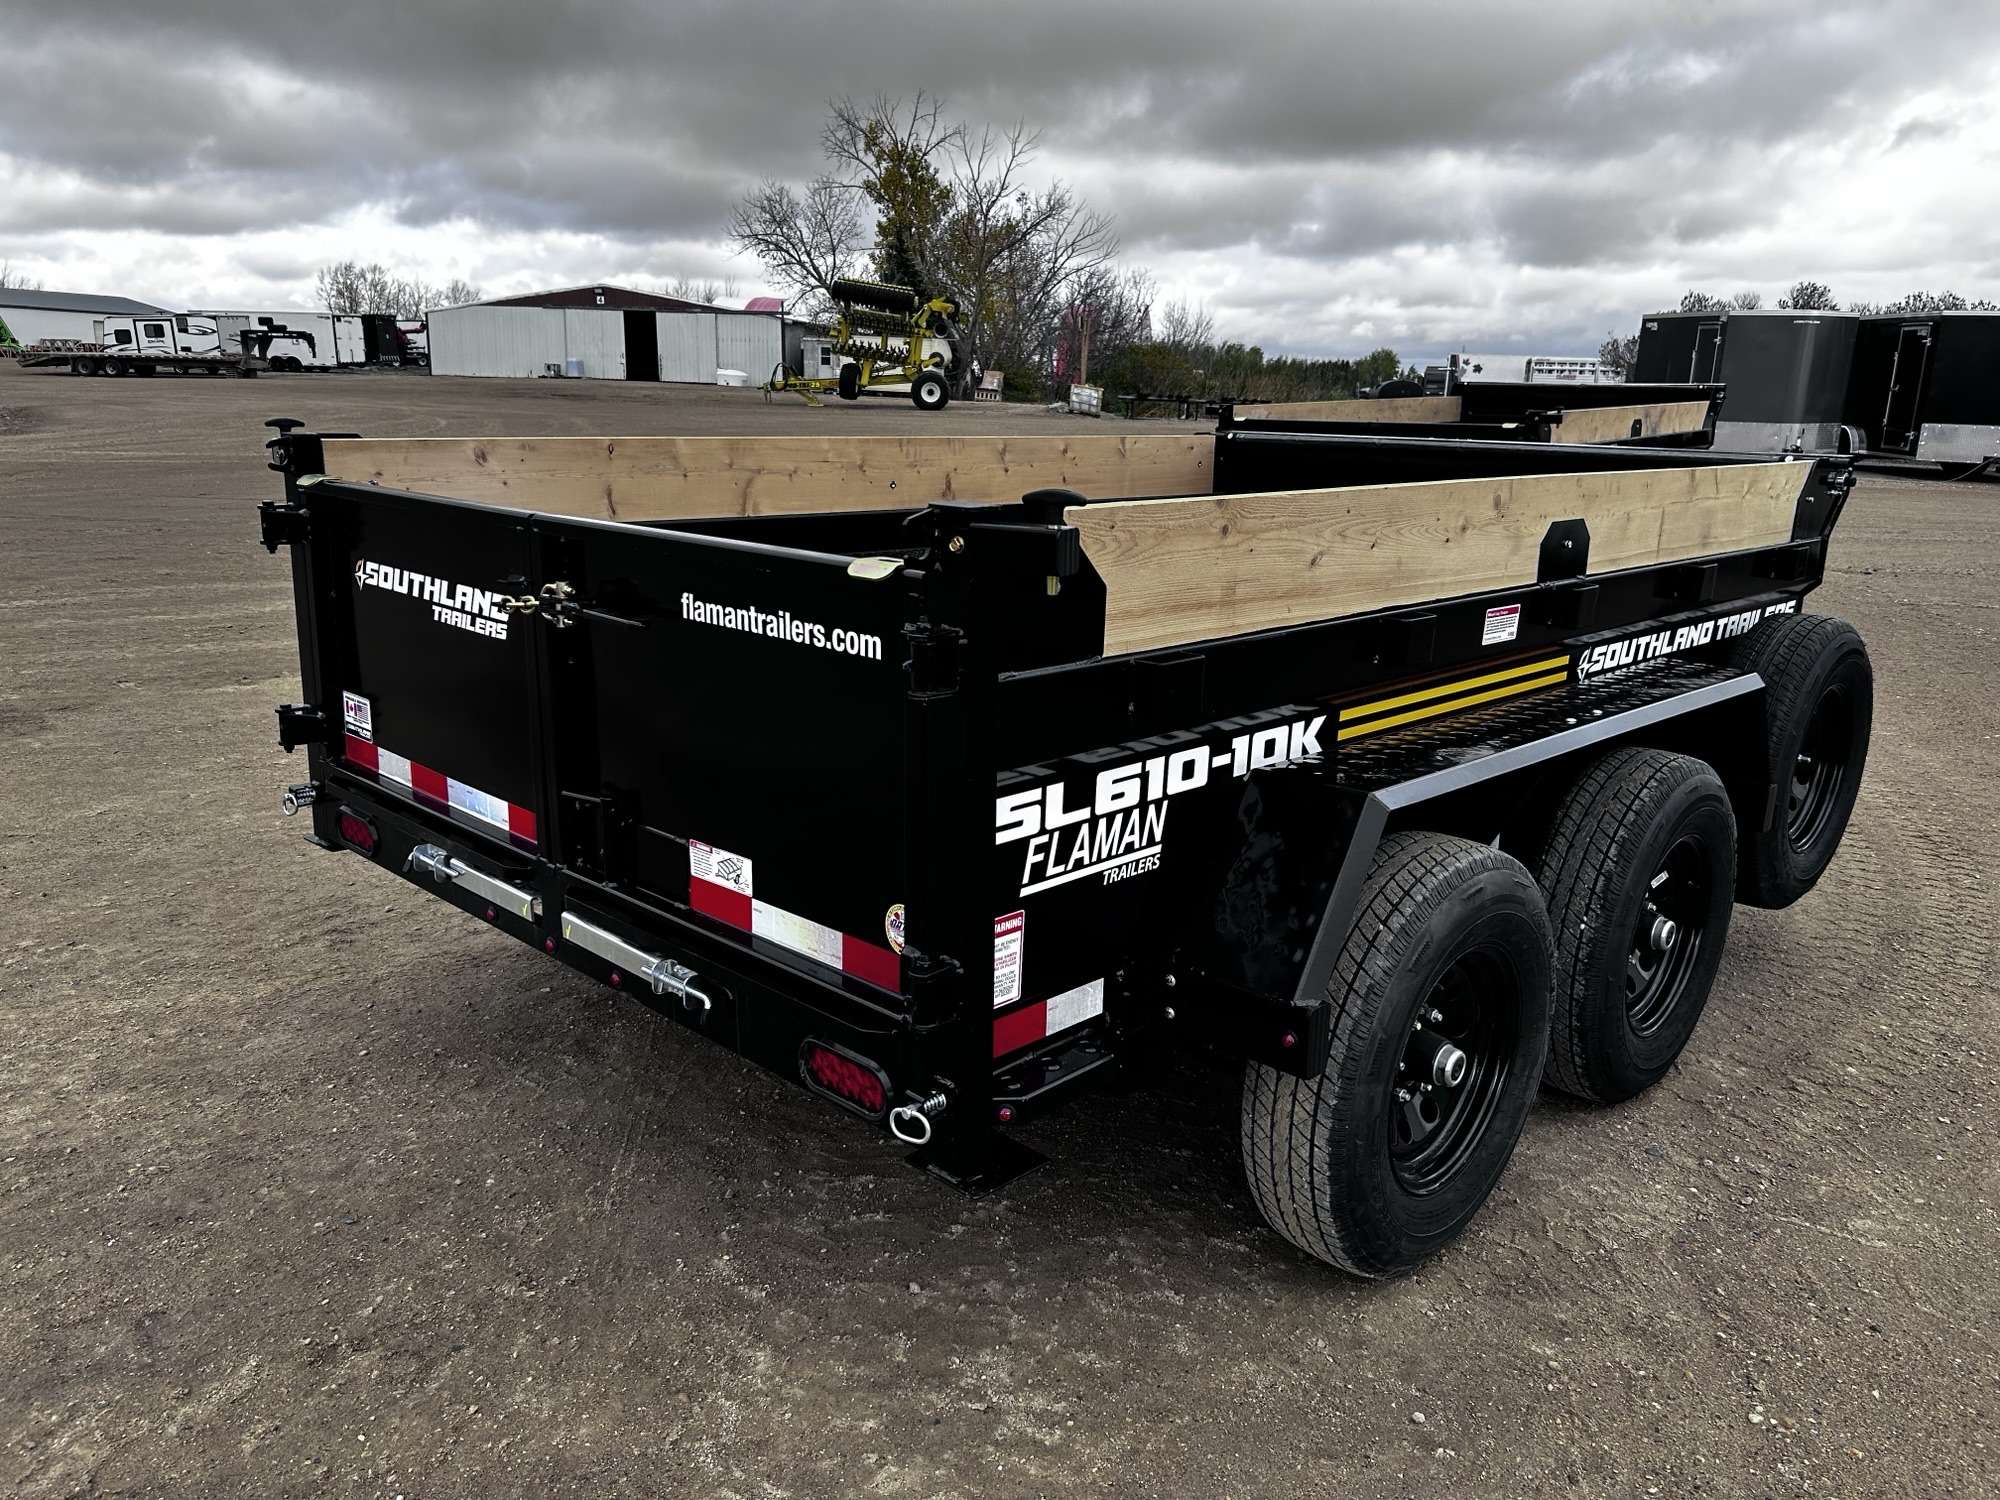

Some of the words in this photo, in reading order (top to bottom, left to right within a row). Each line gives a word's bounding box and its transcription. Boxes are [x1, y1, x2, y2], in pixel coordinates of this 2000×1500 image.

[364, 561, 510, 622] SOUTHLAND
[432, 605, 508, 641] TRAILERS
[680, 592, 882, 661] flamantrailers.com
[1588, 619, 1715, 673] SOUTHLAND
[995, 715, 1327, 845] SL610-10K
[1022, 799, 1169, 885] FLAMAN
[1102, 854, 1161, 886] TRAILERS
